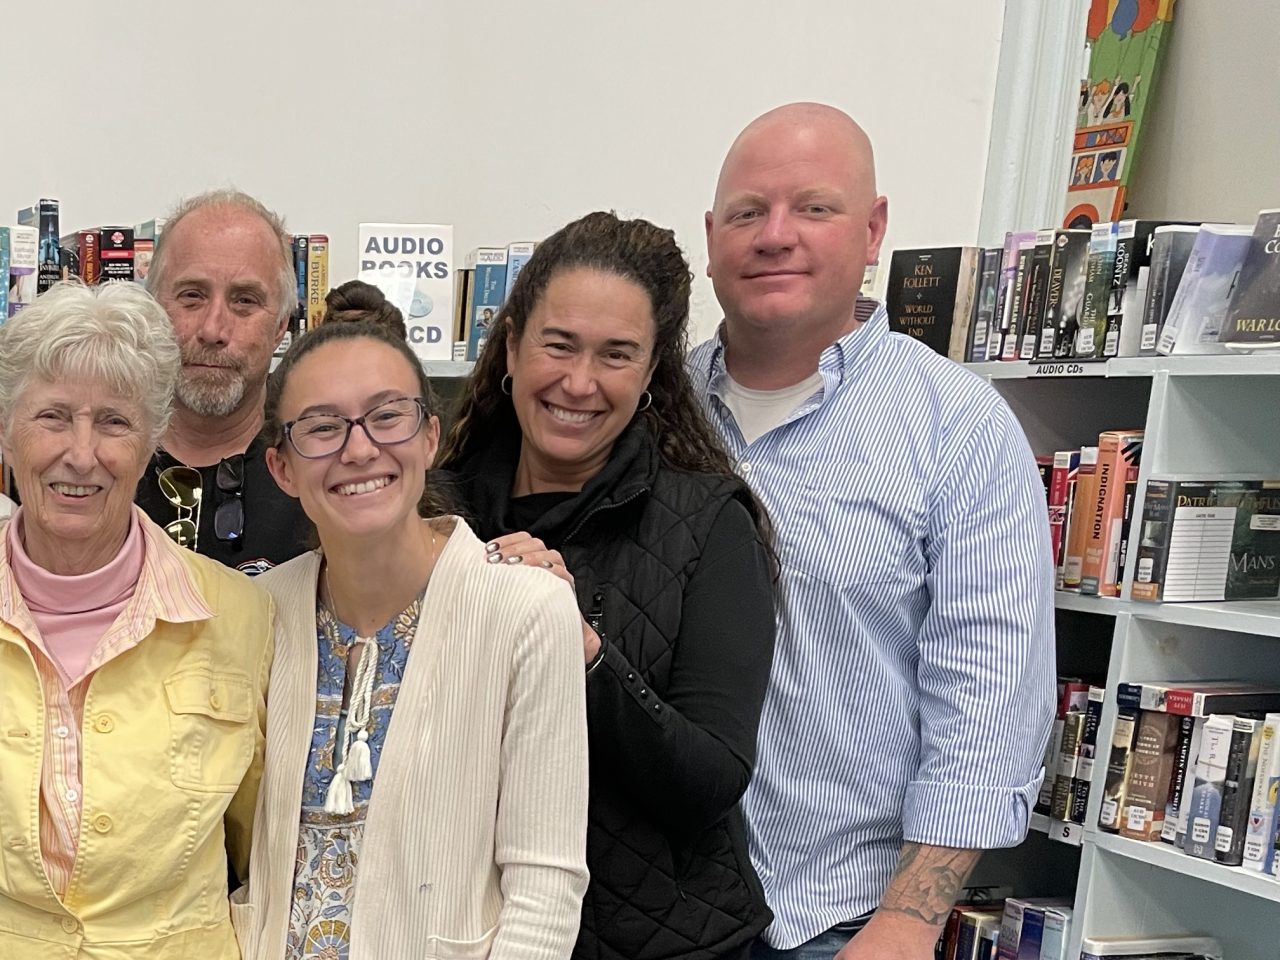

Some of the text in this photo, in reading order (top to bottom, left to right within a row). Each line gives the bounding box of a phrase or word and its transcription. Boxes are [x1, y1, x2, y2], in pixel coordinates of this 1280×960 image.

[365, 236, 444, 255] AUDIO
[361, 260, 449, 279] BOOKS
[914, 264, 933, 275] KEN
[1113, 242, 1126, 286] KOONTZ
[1121, 252, 1130, 274] DEAN
[310, 261, 320, 305] BURKE
[903, 276, 941, 288] FOLLETT
[1016, 270, 1024, 293] AWAY
[1050, 268, 1063, 305] DEAVER
[904, 304, 933, 314] WORLD
[1012, 295, 1020, 323] HARLAN
[899, 315, 936, 326] WITHOUT
[1235, 319, 1267, 332] WAR
[409, 326, 442, 343] CD
[908, 327, 924, 337] END
[1036, 364, 1084, 375] AUDIO CDs
[1093, 463, 1110, 540] INDIGNATION
[1179, 738, 1189, 769] MARTIN
[1062, 826, 1071, 838] S
